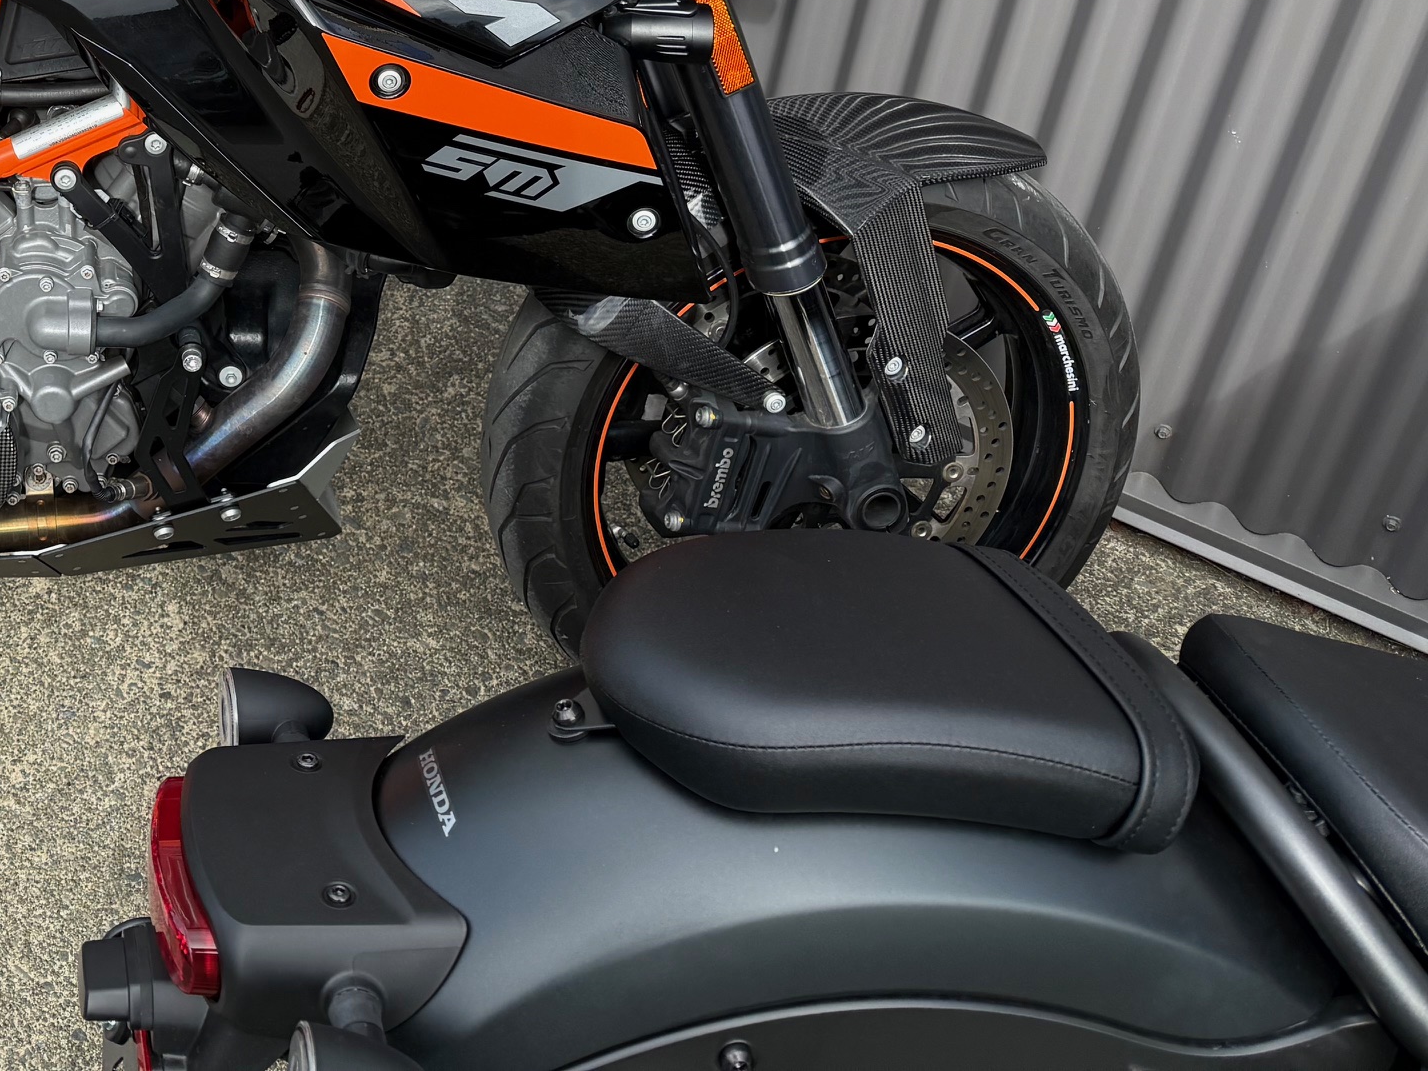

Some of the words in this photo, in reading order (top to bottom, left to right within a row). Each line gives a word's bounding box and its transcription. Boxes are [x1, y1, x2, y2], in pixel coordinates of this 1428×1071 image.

[982, 227, 1038, 264] GRAN
[1042, 268, 1094, 340] TURISMO
[1053, 333, 1080, 392] marchesini
[703, 448, 734, 508] brembo
[419, 749, 456, 837] HONDA
